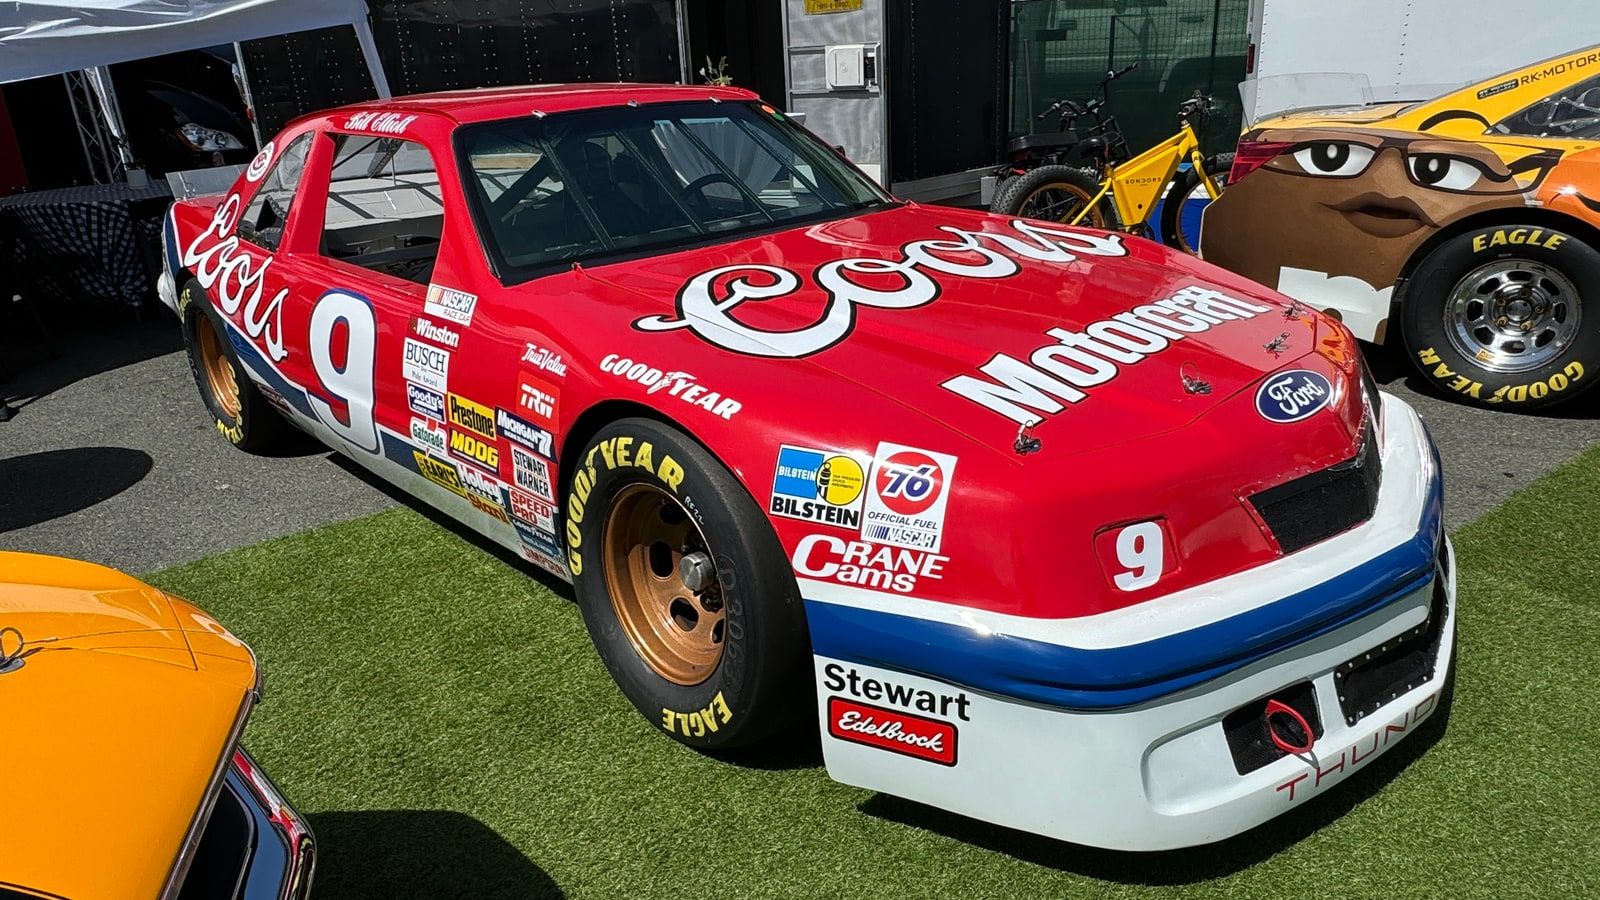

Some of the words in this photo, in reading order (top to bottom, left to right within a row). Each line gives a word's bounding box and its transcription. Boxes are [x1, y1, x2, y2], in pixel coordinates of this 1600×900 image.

[1521, 52, 1600, 85] RK-MOTOR
[344, 111, 380, 131] Bill
[371, 112, 419, 134] Elliott
[1473, 229, 1568, 252] EAGLE
[184, 193, 290, 361] Coors
[632, 217, 1129, 358] Coors
[440, 289, 474, 313] NASCAR
[443, 308, 459, 319] RACE
[416, 317, 460, 348] Winston
[308, 287, 381, 455] 9
[406, 341, 447, 373] BUSCH
[941, 286, 1273, 424] Motorcraft
[408, 385, 444, 410] Goody's
[520, 383, 556, 420] TRW
[1267, 376, 1327, 416] Ford
[451, 395, 495, 438] Prestone
[412, 422, 445, 450] Gatorade
[450, 429, 499, 468] MOOG
[514, 449, 547, 480] STEWART
[778, 465, 817, 481] BILSTEIN
[457, 462, 506, 506] Holley
[516, 467, 551, 499] WARNER
[882, 464, 937, 501] 76
[511, 489, 550, 518] SPEED
[512, 503, 538, 525] PRO
[772, 496, 860, 527] BILSTEIN
[868, 511, 911, 526] OFFICIAL
[912, 518, 938, 530] FUEL
[886, 526, 938, 549] NASCAR
[792, 534, 950, 579] CRANE
[1113, 521, 1164, 592] 9
[823, 663, 971, 722] Stewart
[662, 690, 734, 738] EAGLE
[838, 710, 944, 753] Edelbrock
[1276, 693, 1437, 801] THUND
